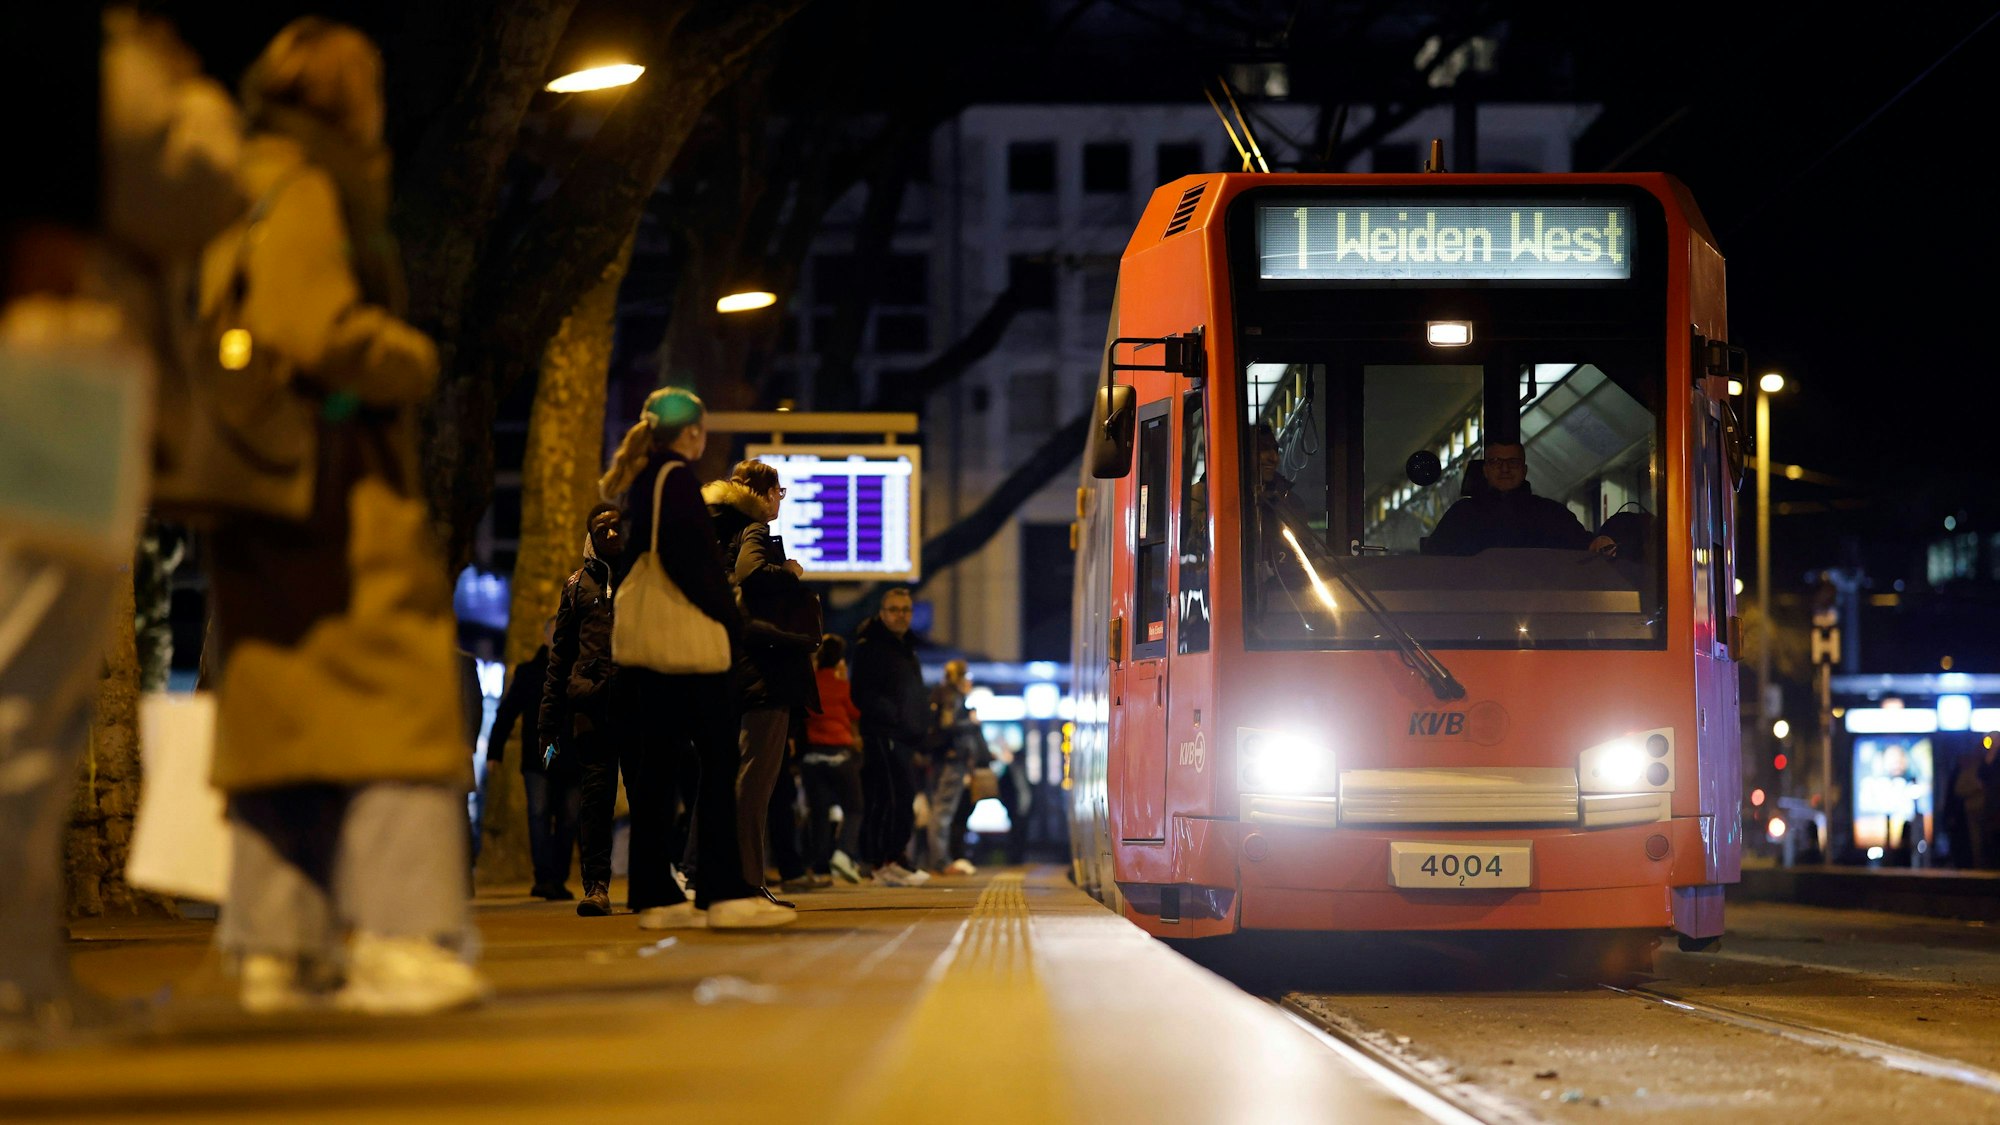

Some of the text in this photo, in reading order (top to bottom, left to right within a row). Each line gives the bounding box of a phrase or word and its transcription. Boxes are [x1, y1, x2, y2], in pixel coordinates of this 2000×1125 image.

[1294, 207, 1623, 269] 1 Weiden West
[1408, 712, 1466, 736] KVB
[1179, 742, 1195, 766] KVB
[1421, 854, 1503, 877] 4004
[1459, 875, 1465, 887] 2
